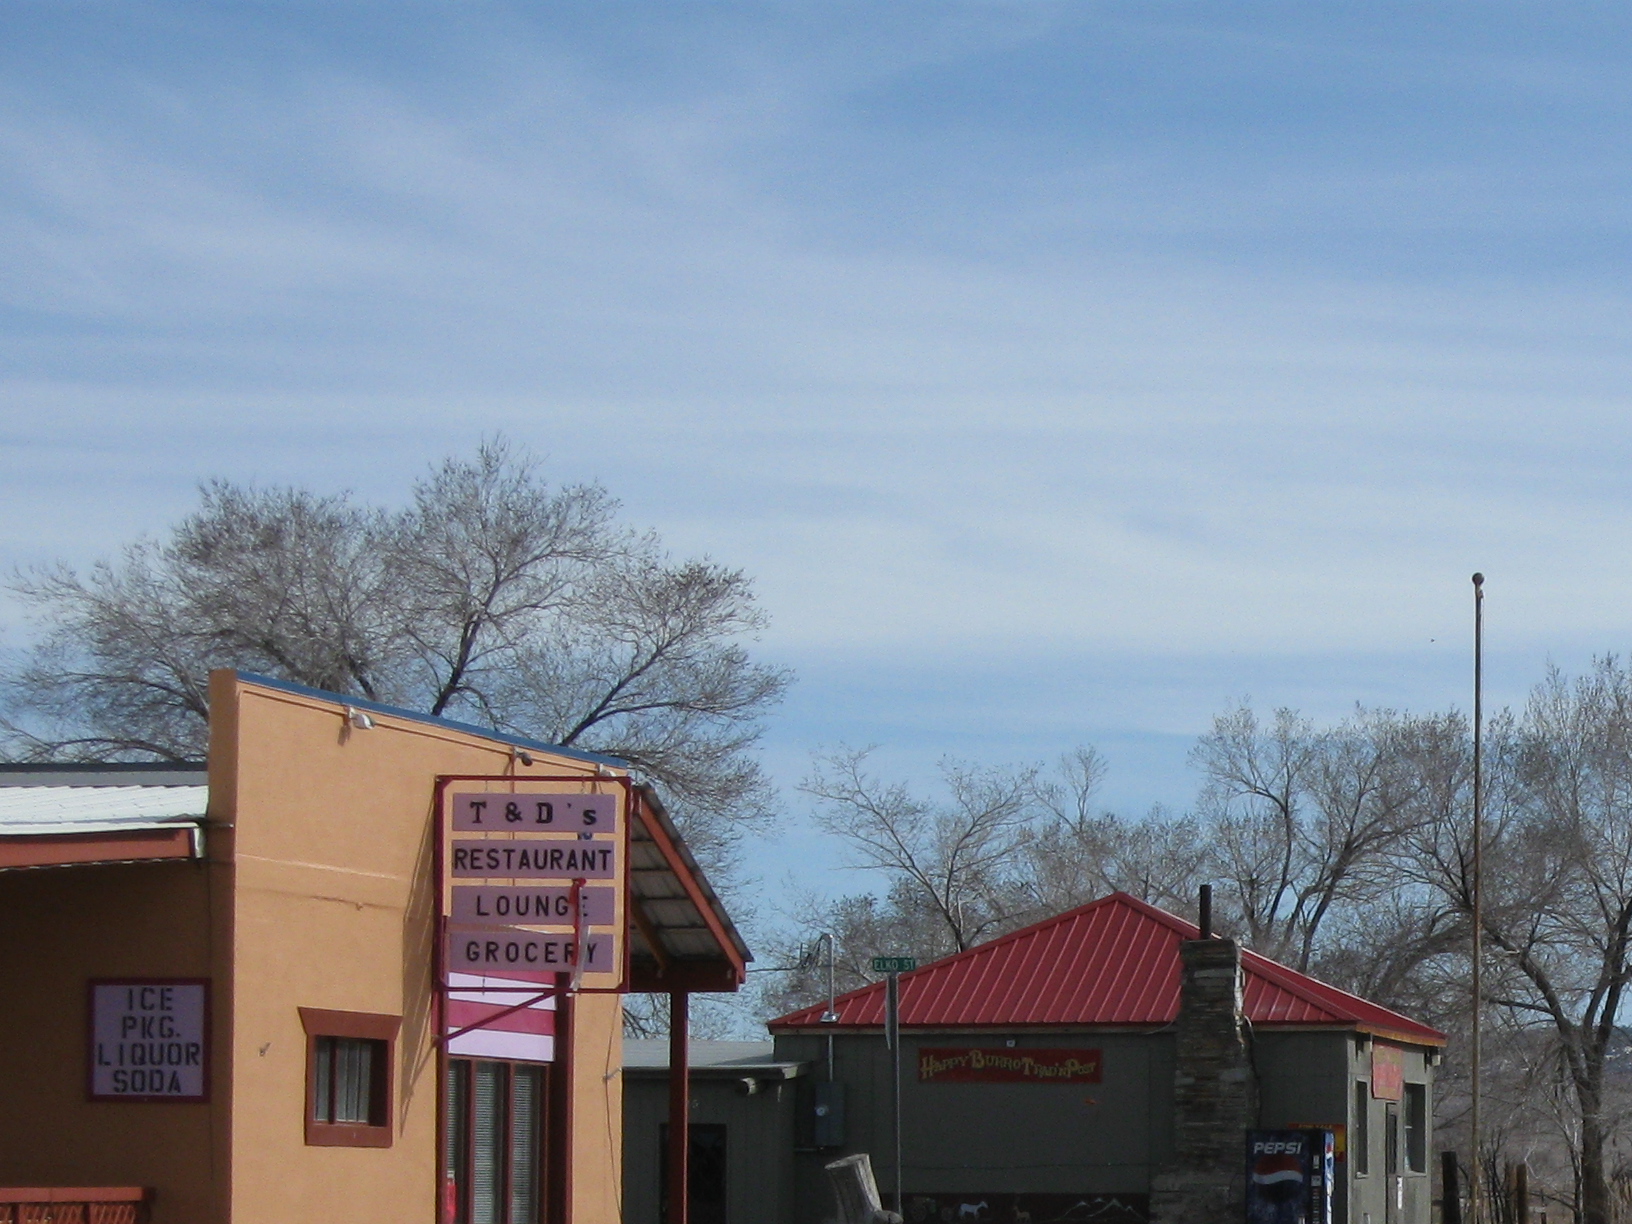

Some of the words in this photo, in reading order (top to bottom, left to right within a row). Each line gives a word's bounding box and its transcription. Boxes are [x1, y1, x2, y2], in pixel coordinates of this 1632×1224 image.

[454, 848, 611, 871] RESTAURANT
[873, 959, 899, 970] ELKO
[128, 987, 173, 1011] ICE
[122, 1016, 181, 1039] PKG.
[98, 1042, 200, 1067] LIQUOR
[113, 1069, 181, 1093] SODA
[1253, 1142, 1302, 1154] PEPSI
